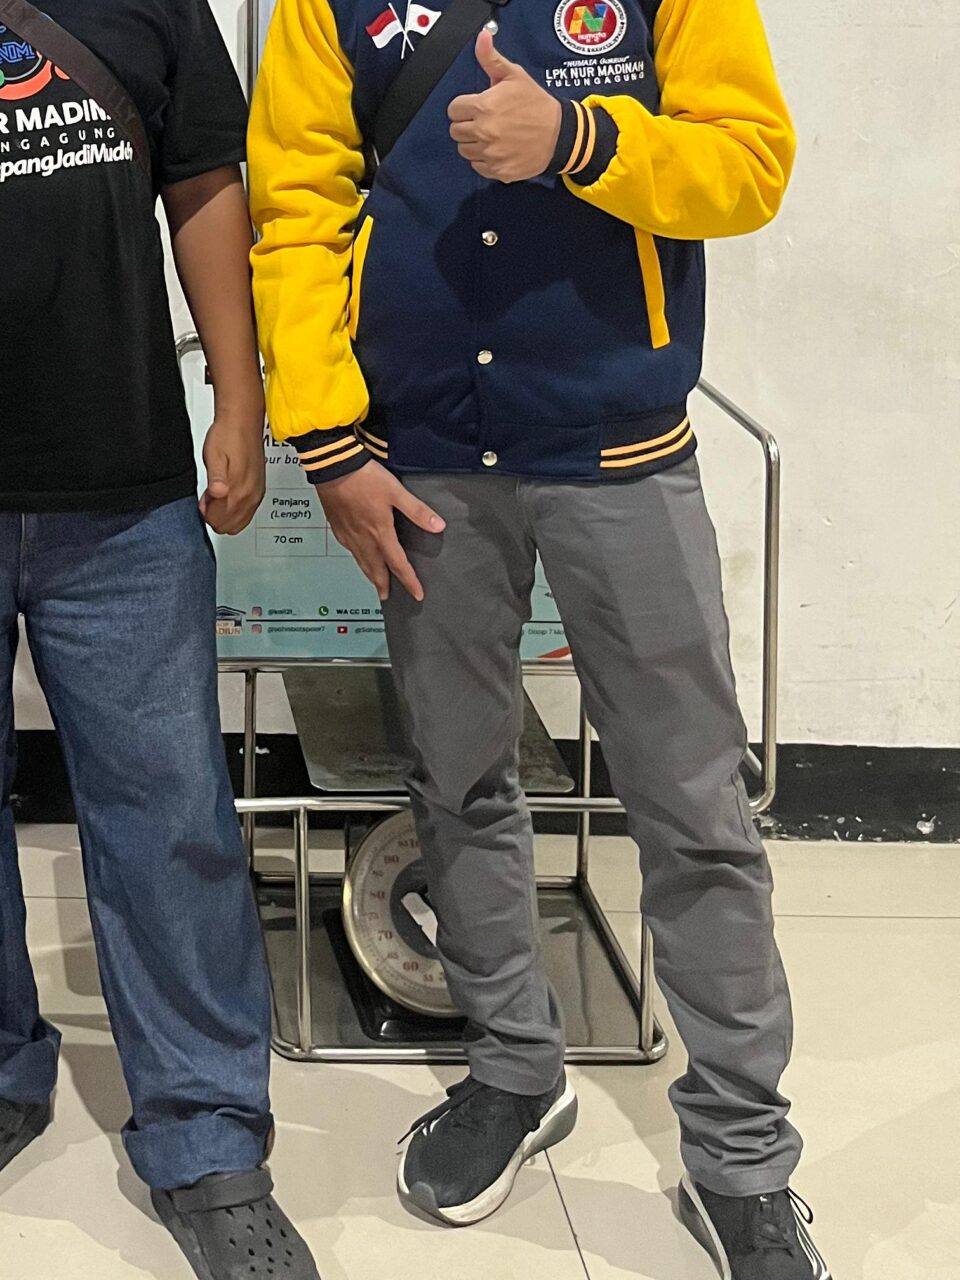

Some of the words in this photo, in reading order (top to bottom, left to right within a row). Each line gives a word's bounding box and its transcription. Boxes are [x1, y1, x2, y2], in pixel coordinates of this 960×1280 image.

[545, 68, 568, 80] LPK
[570, 66, 595, 79] NUR
[597, 60, 645, 74] MADINAH
[545, 72, 645, 88] TULUNGAGUNG
[272, 496, 310, 509] Panjang
[270, 509, 311, 521] (Lenght)
[273, 534, 288, 545] 70
[289, 536, 304, 545] cm
[403, 960, 419, 971] 60
